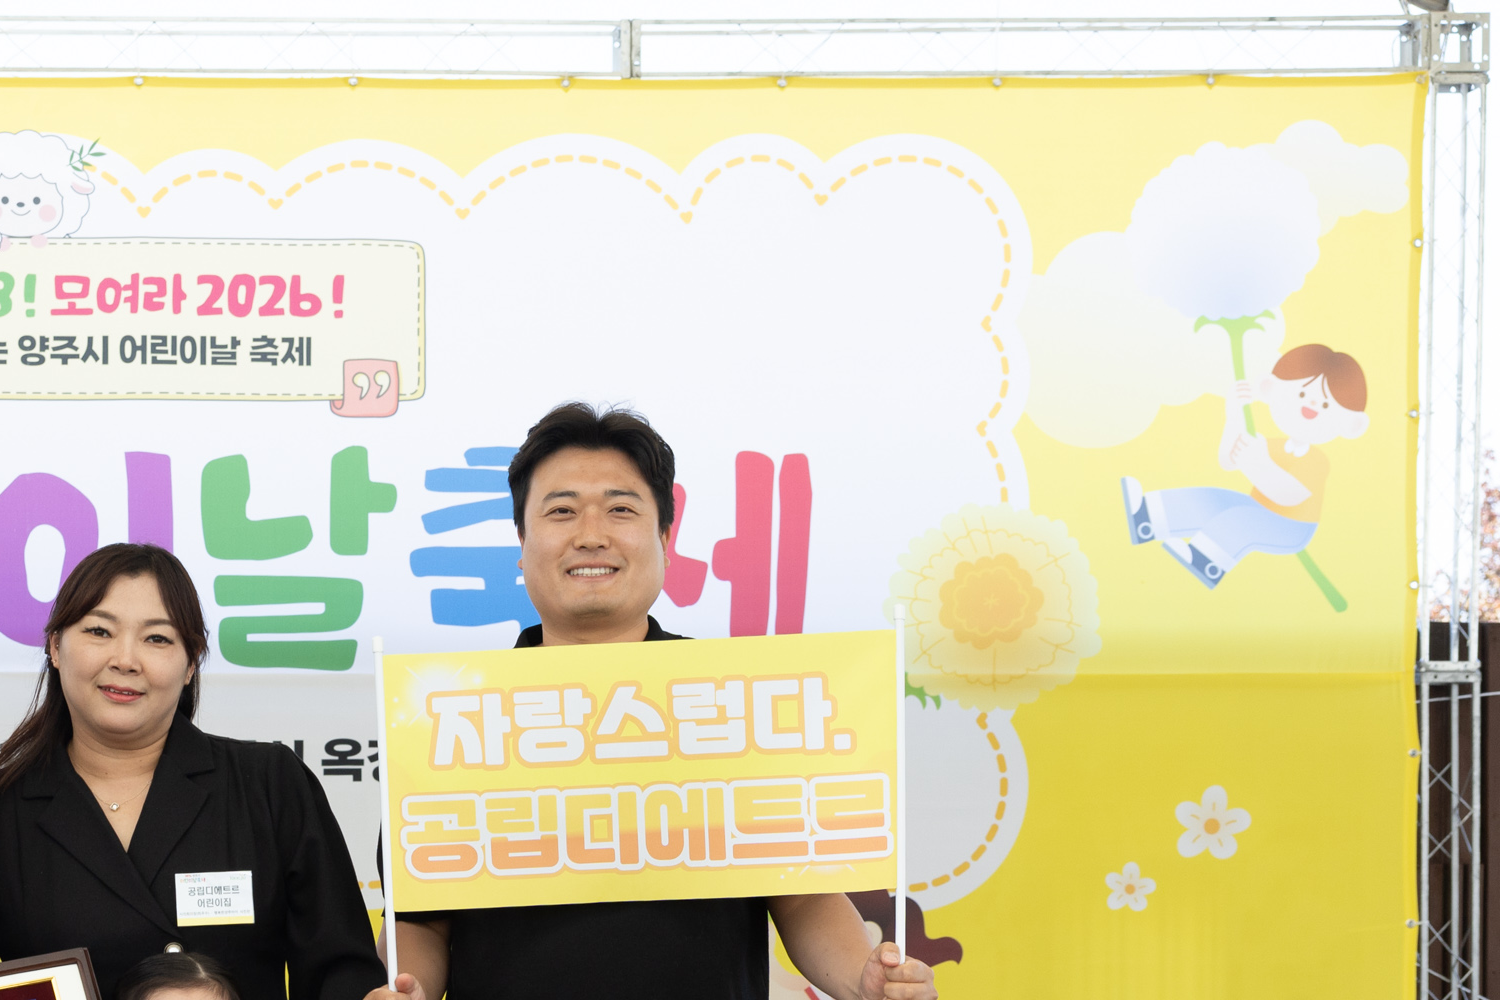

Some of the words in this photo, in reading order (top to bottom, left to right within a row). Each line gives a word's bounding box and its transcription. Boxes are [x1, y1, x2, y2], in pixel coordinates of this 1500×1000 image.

[50, 273, 187, 316] 모여라
[196, 273, 346, 319] 2026!
[17, 334, 110, 366] 양주시
[119, 334, 242, 366] 어린이날
[249, 333, 313, 367] 축제
[429, 674, 853, 768] 자랑스럽다.
[402, 772, 893, 879] 공립디에트르
[188, 885, 240, 896] 공립디에트르
[197, 898, 232, 908] 어린이집
